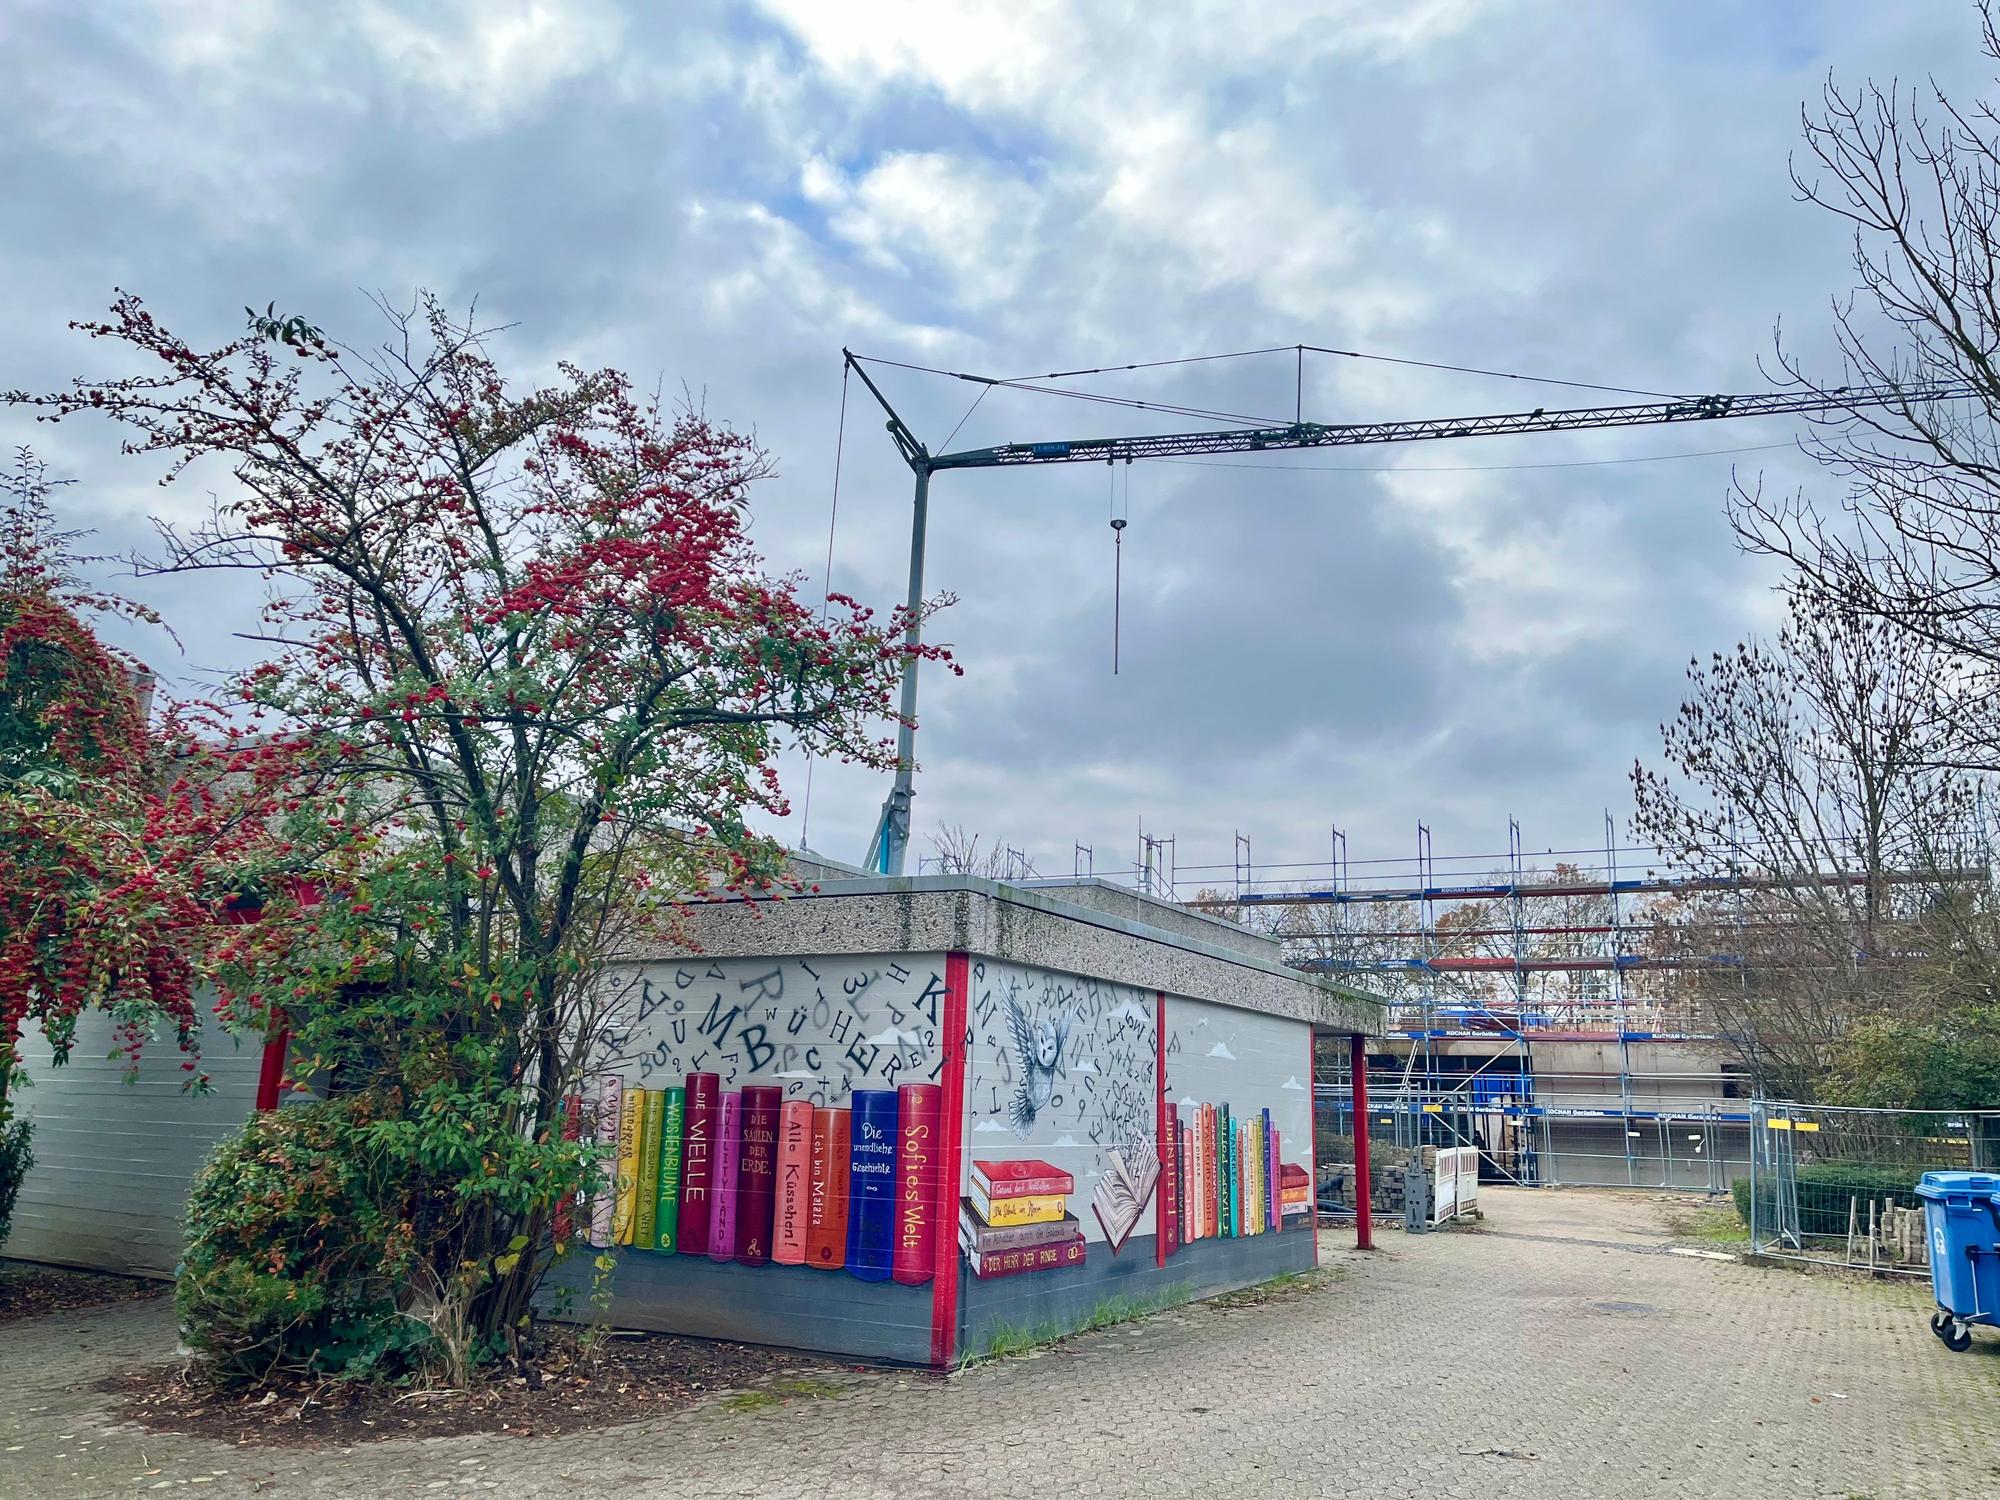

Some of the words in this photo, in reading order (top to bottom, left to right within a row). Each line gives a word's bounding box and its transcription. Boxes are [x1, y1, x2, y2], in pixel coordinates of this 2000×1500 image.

[696, 1092, 706, 1109] DIE
[751, 1115, 768, 1125] DIE
[861, 1122, 883, 1139] Die
[646, 1119, 658, 1180] VERMESSUNG
[789, 1121, 802, 1152] Alle
[814, 1133, 824, 1153] Ich
[661, 1102, 681, 1207] WÜSTENBLUME
[686, 1119, 707, 1204] WELLE
[749, 1146, 768, 1157] DER
[902, 1125, 929, 1201] Sofies
[741, 1158, 772, 1175] ERDE.
[813, 1159, 823, 1176] bin
[643, 1189, 652, 1206] DER
[784, 1164, 800, 1248] Küsschen!
[812, 1181, 825, 1226] Malala
[1221, 1169, 1229, 1217] HARRY
[640, 1211, 651, 1237] WELT
[903, 1205, 925, 1248] Welt
[988, 1256, 1001, 1272] DER
[1003, 1254, 1020, 1270] HERR
[1023, 1252, 1036, 1267] DER
[1040, 1249, 1058, 1264] RINGE
